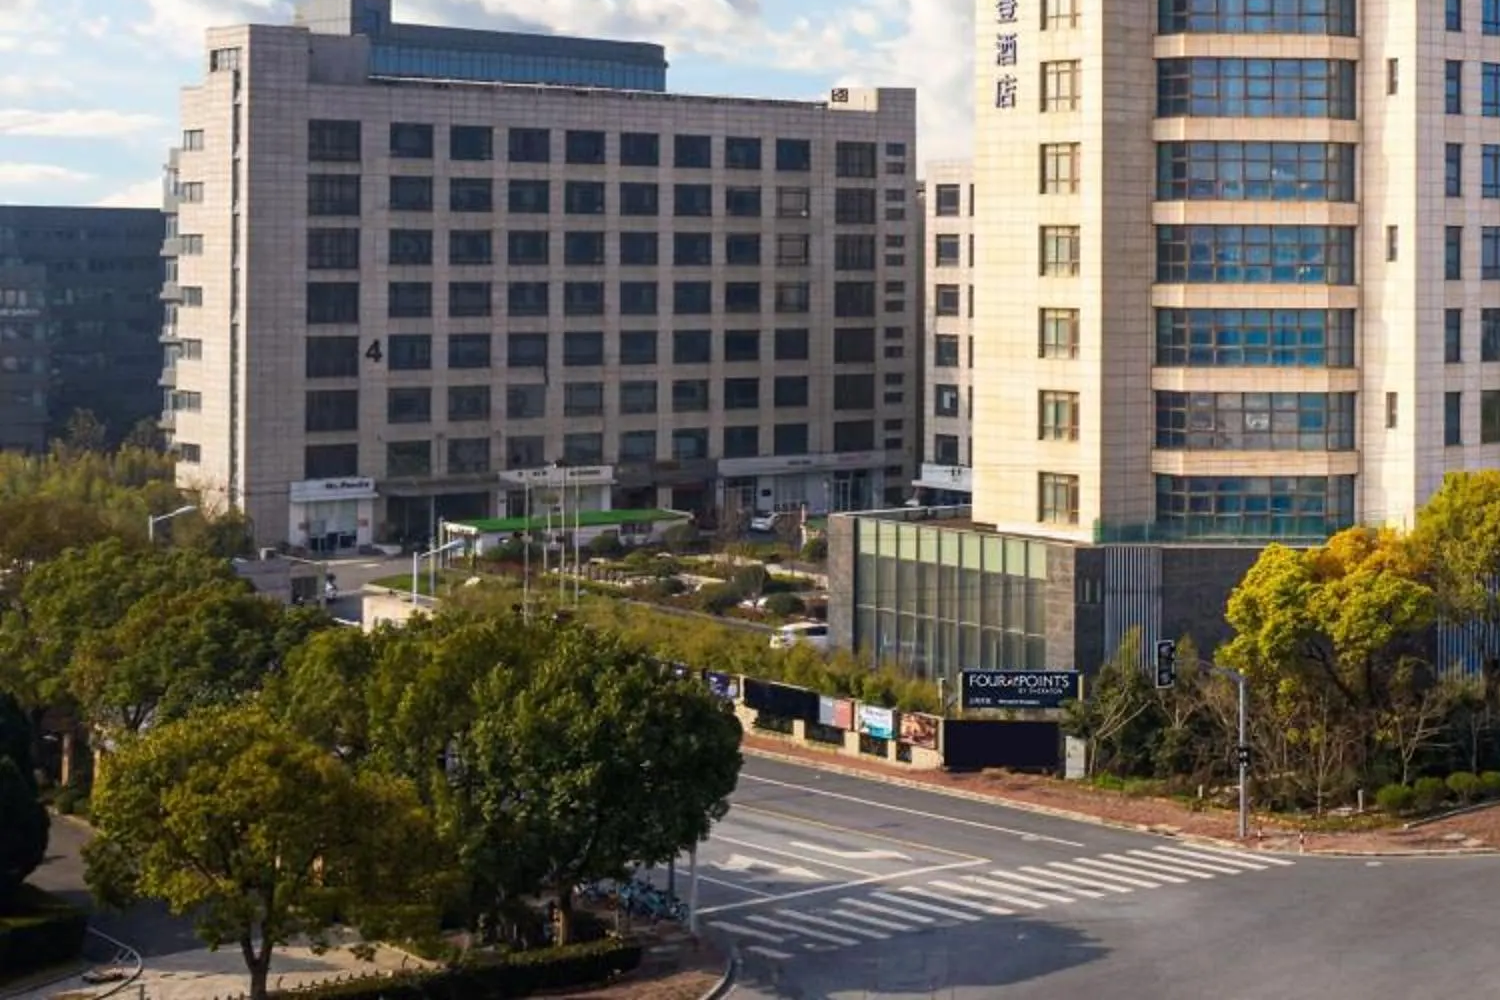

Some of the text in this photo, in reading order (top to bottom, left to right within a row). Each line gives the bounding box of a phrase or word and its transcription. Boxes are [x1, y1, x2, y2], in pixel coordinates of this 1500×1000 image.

[365, 339, 383, 363] 4
[969, 674, 1070, 687] FOUR POINTS
